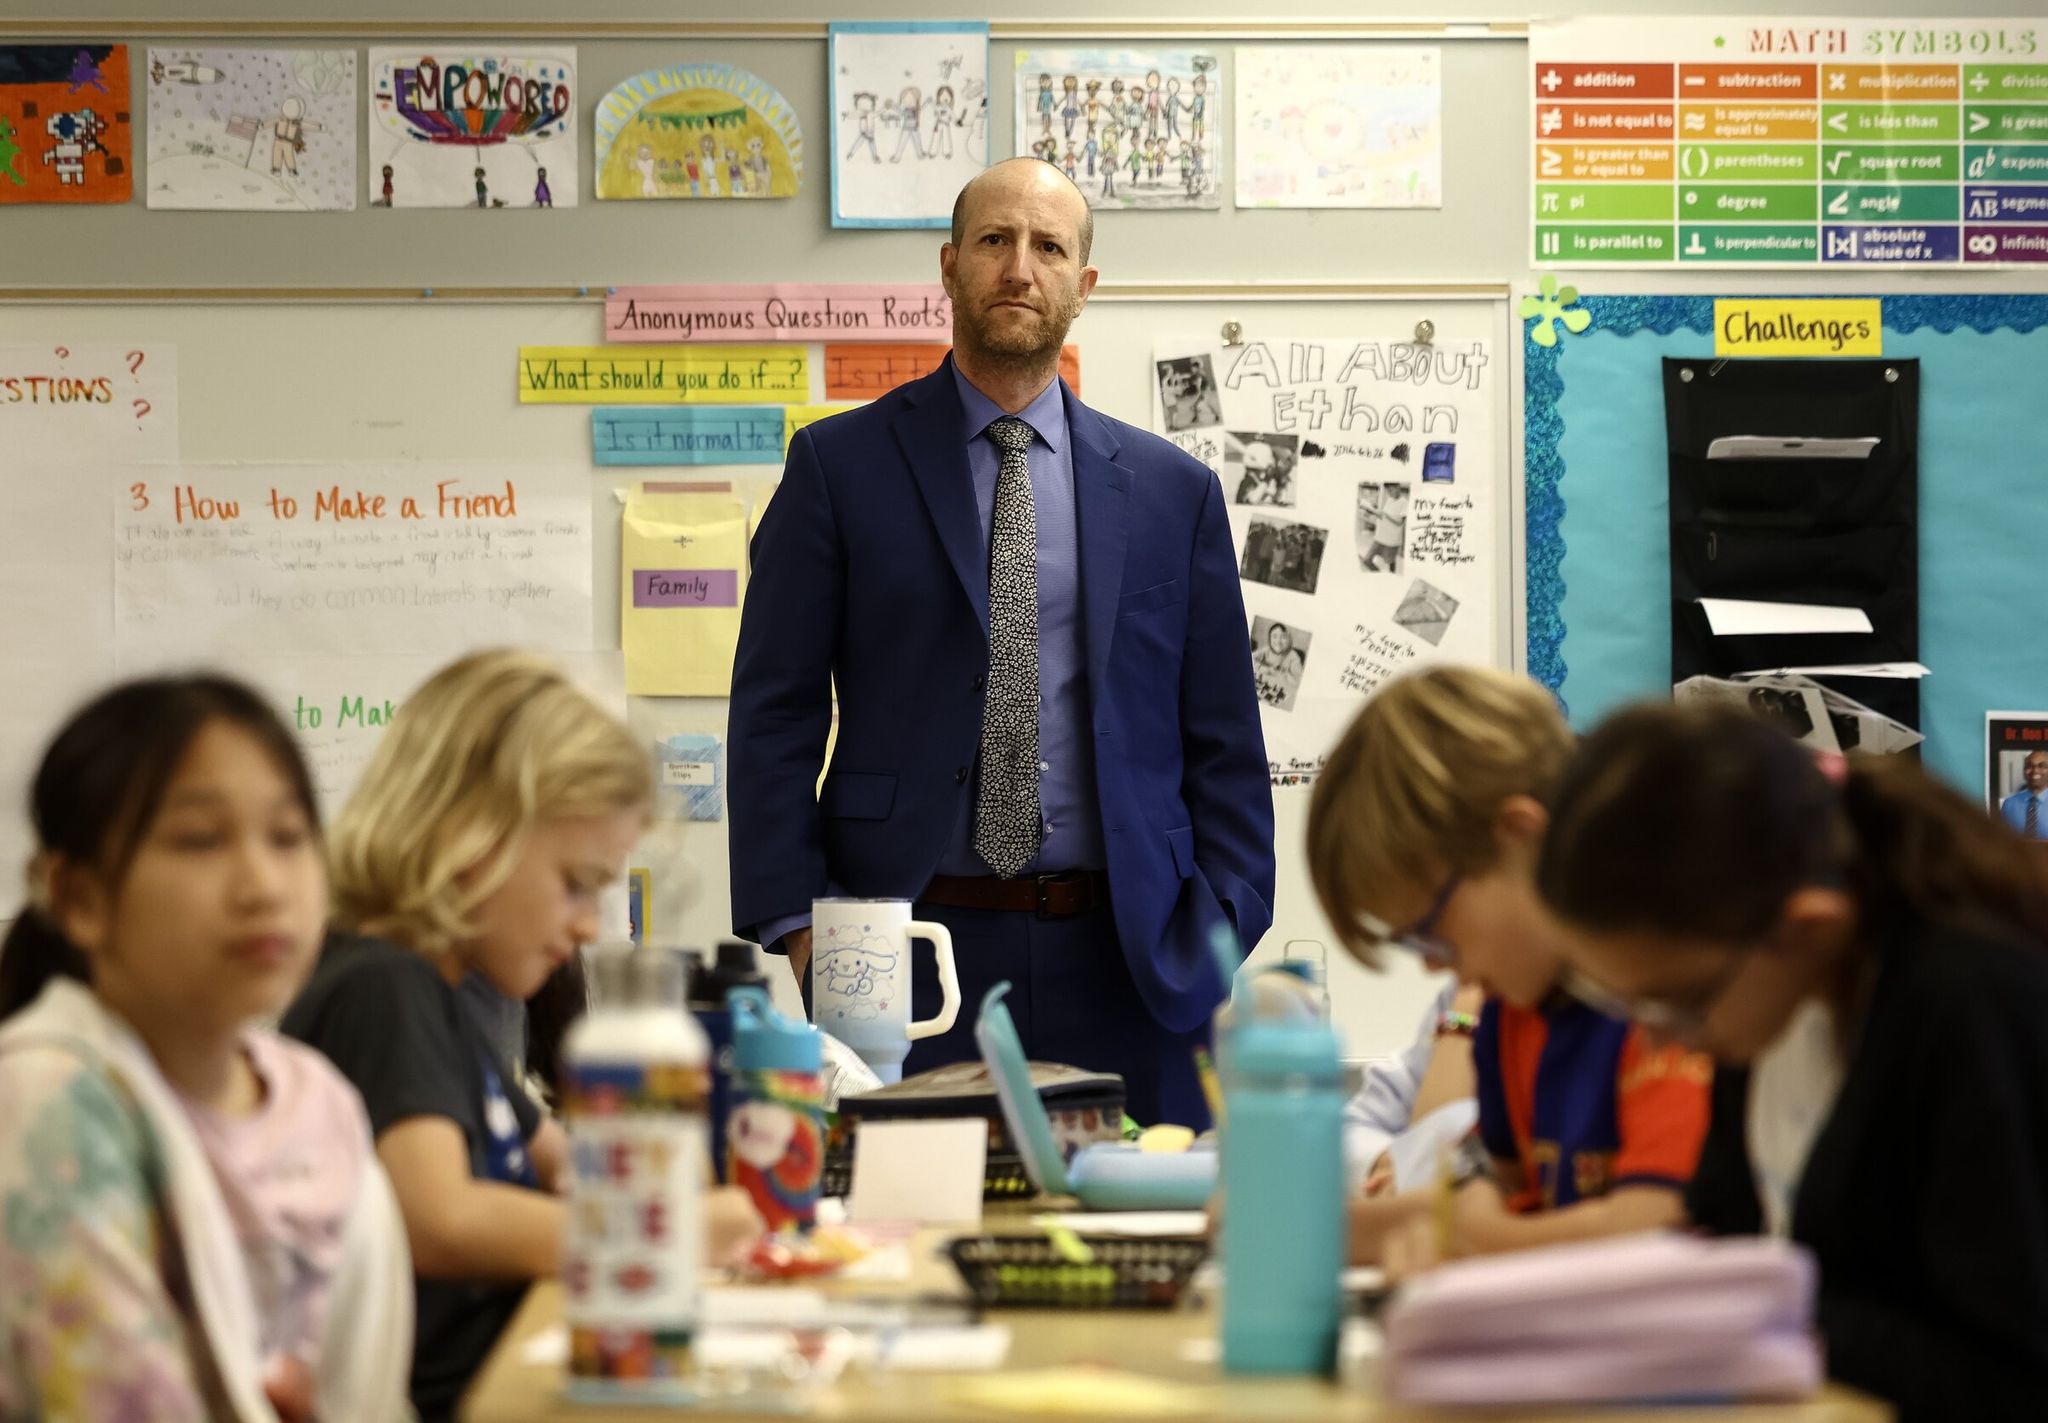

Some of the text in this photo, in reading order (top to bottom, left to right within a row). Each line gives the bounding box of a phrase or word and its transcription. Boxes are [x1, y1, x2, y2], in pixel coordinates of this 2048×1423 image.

[1749, 29, 2038, 55] MATH SYMBOLS
[1574, 72, 1636, 87] addition
[1718, 72, 1801, 87] subtraction
[1859, 74, 1957, 91] multiplication
[1574, 112, 1673, 131] is not equal to
[1715, 107, 1818, 124] is approximately
[1860, 115, 1938, 129] is less than
[2002, 115, 2013, 129] is
[1715, 123, 1768, 138] equal to
[1574, 148, 1669, 164] is greater than
[1715, 155, 1804, 170] parentheses
[1860, 156, 1942, 171] square root
[1574, 163, 1645, 179] or equal to
[1570, 195, 1585, 210] pi
[1716, 195, 1767, 212] degree
[1860, 196, 1901, 212] angle
[1574, 235, 1663, 252] is parallel to
[1715, 236, 1816, 252] is perpendicular to
[1863, 229, 1926, 243] absolute
[1863, 246, 1933, 259] value of x
[614, 296, 947, 339] Anonymous Question Roots
[1724, 310, 1870, 352] Challenges
[831, 357, 865, 388] Is
[877, 357, 899, 387] it
[1225, 343, 1325, 391] All
[525, 359, 593, 391] What
[600, 358, 664, 390] should
[676, 371, 709, 399] you
[718, 363, 740, 390] do
[1273, 386, 1459, 435] Ethan
[606, 420, 635, 452] Is
[647, 420, 663, 451] it
[672, 420, 740, 451] normal
[130, 479, 518, 524] 3 How to Make a Friend
[648, 574, 709, 602] Family
[293, 695, 323, 731] to
